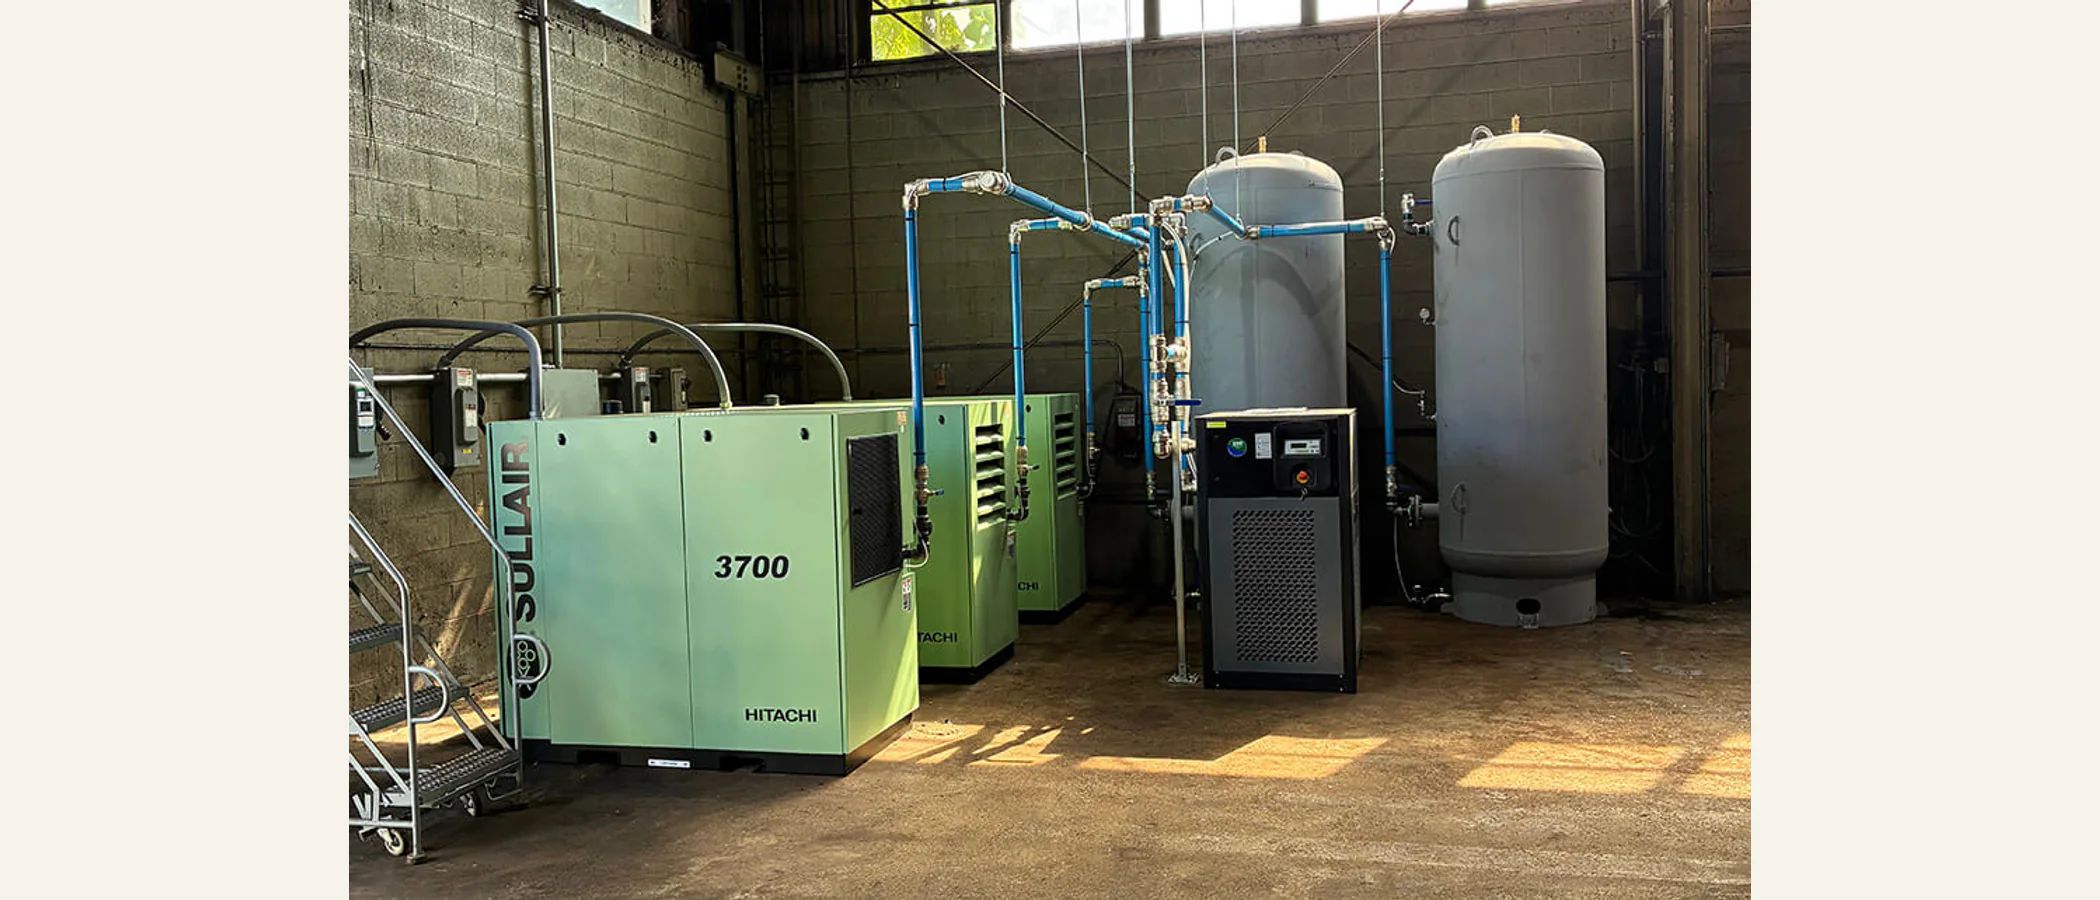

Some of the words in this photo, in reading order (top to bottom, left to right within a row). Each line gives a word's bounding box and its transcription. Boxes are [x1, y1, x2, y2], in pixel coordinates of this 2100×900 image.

[501, 441, 536, 623] SULLAIR
[714, 555, 789, 579] 3700
[918, 632, 958, 643] TACHI
[745, 708, 817, 723] HITACHI
